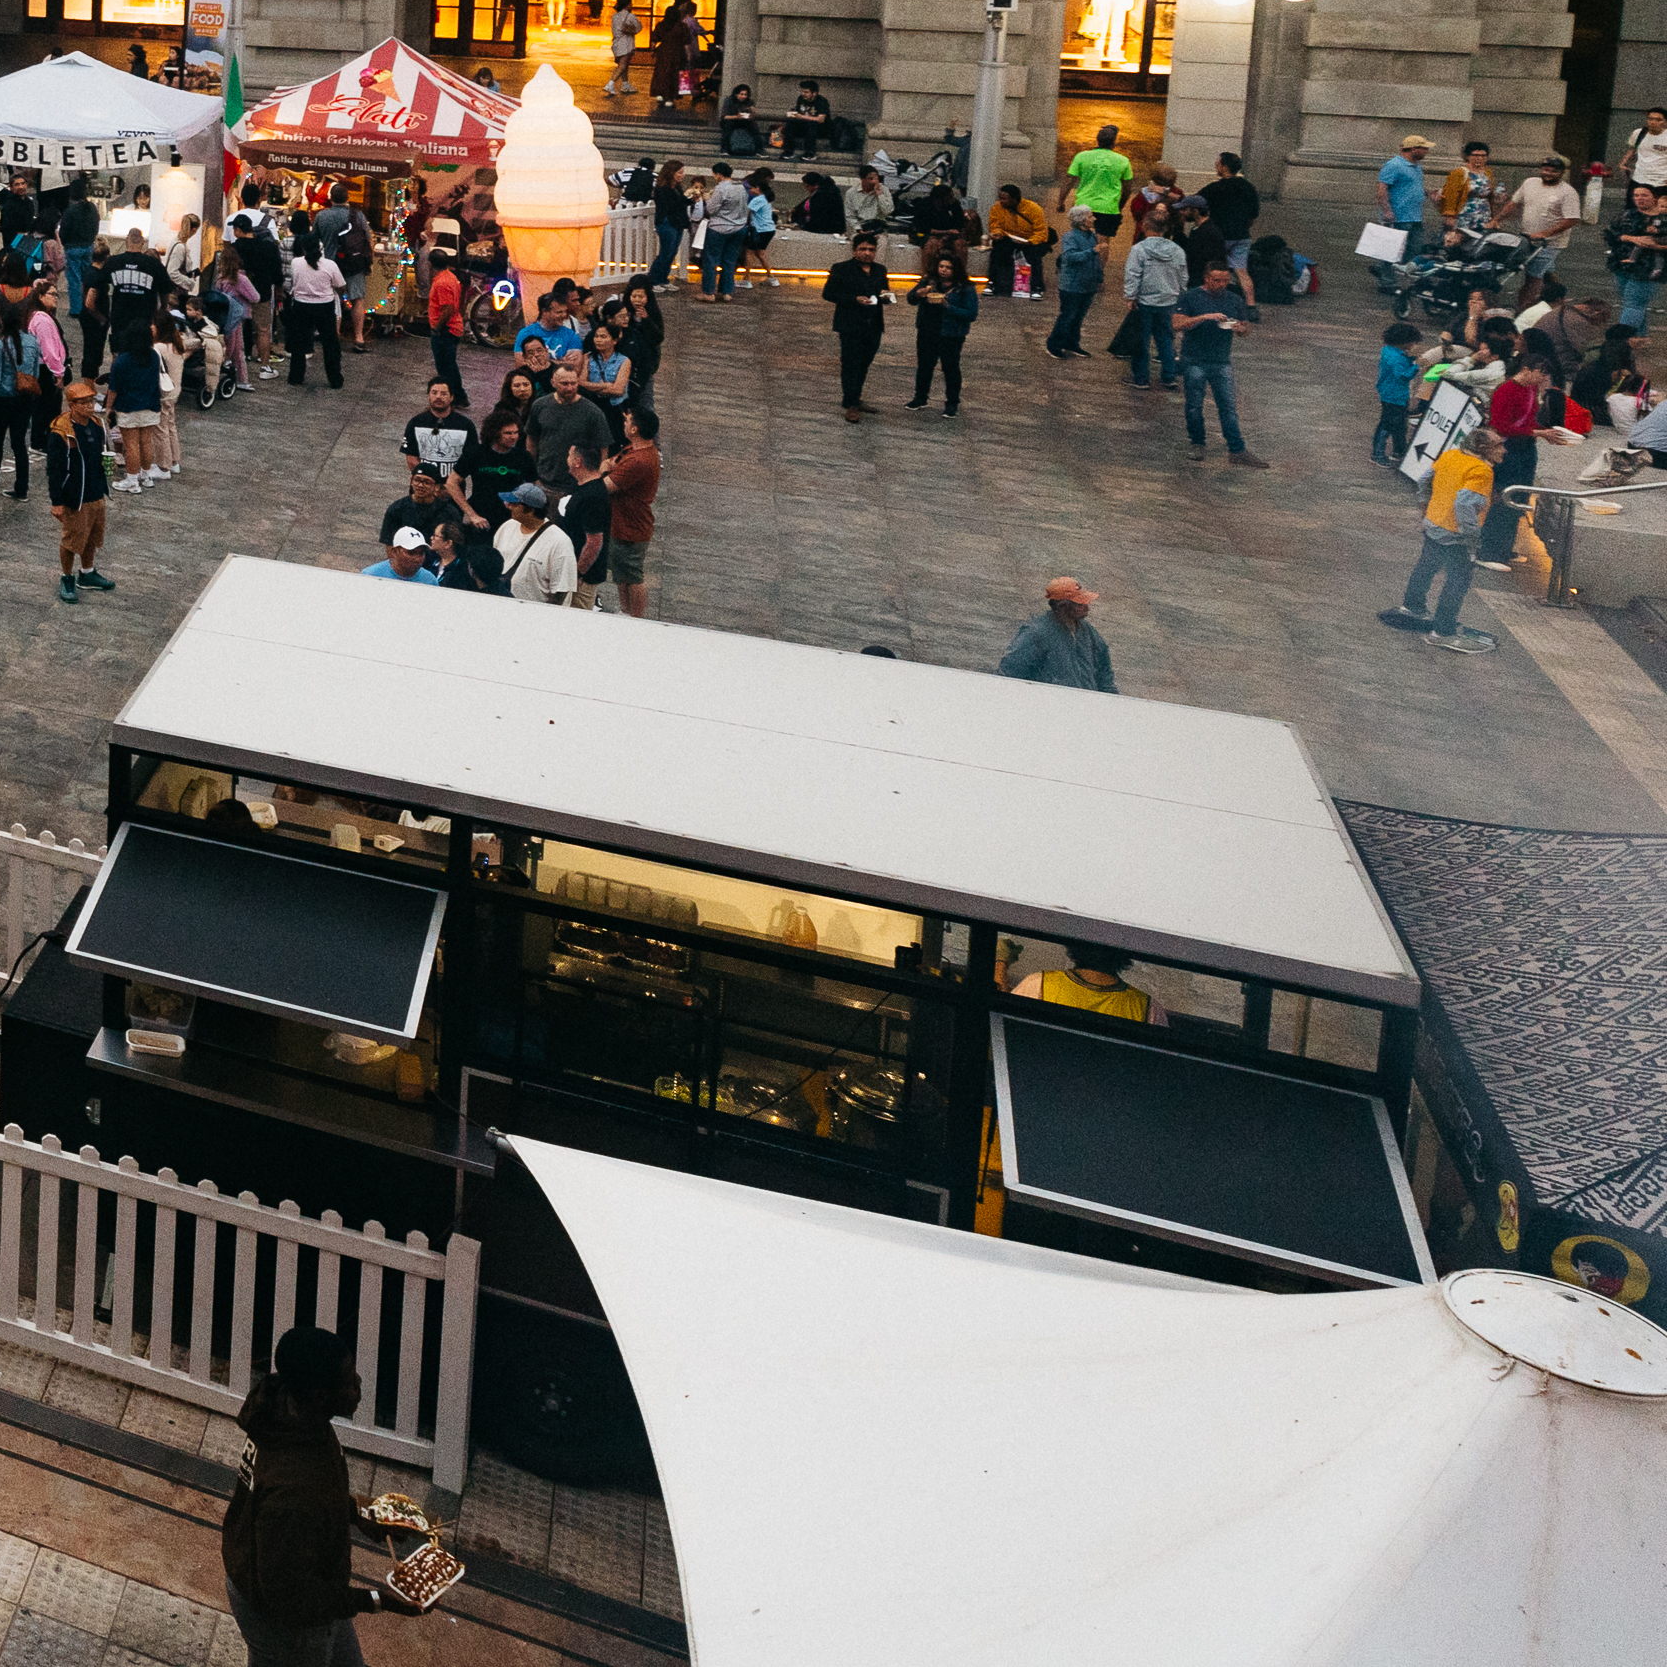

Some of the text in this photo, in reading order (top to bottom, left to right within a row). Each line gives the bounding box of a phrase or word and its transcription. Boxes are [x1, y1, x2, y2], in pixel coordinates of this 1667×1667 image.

[192, 13, 223, 25] FOOD
[309, 94, 427, 130] Gelati
[268, 153, 388, 173] Antica Gelateria Italiana
[1426, 407, 1456, 434] TOILE
